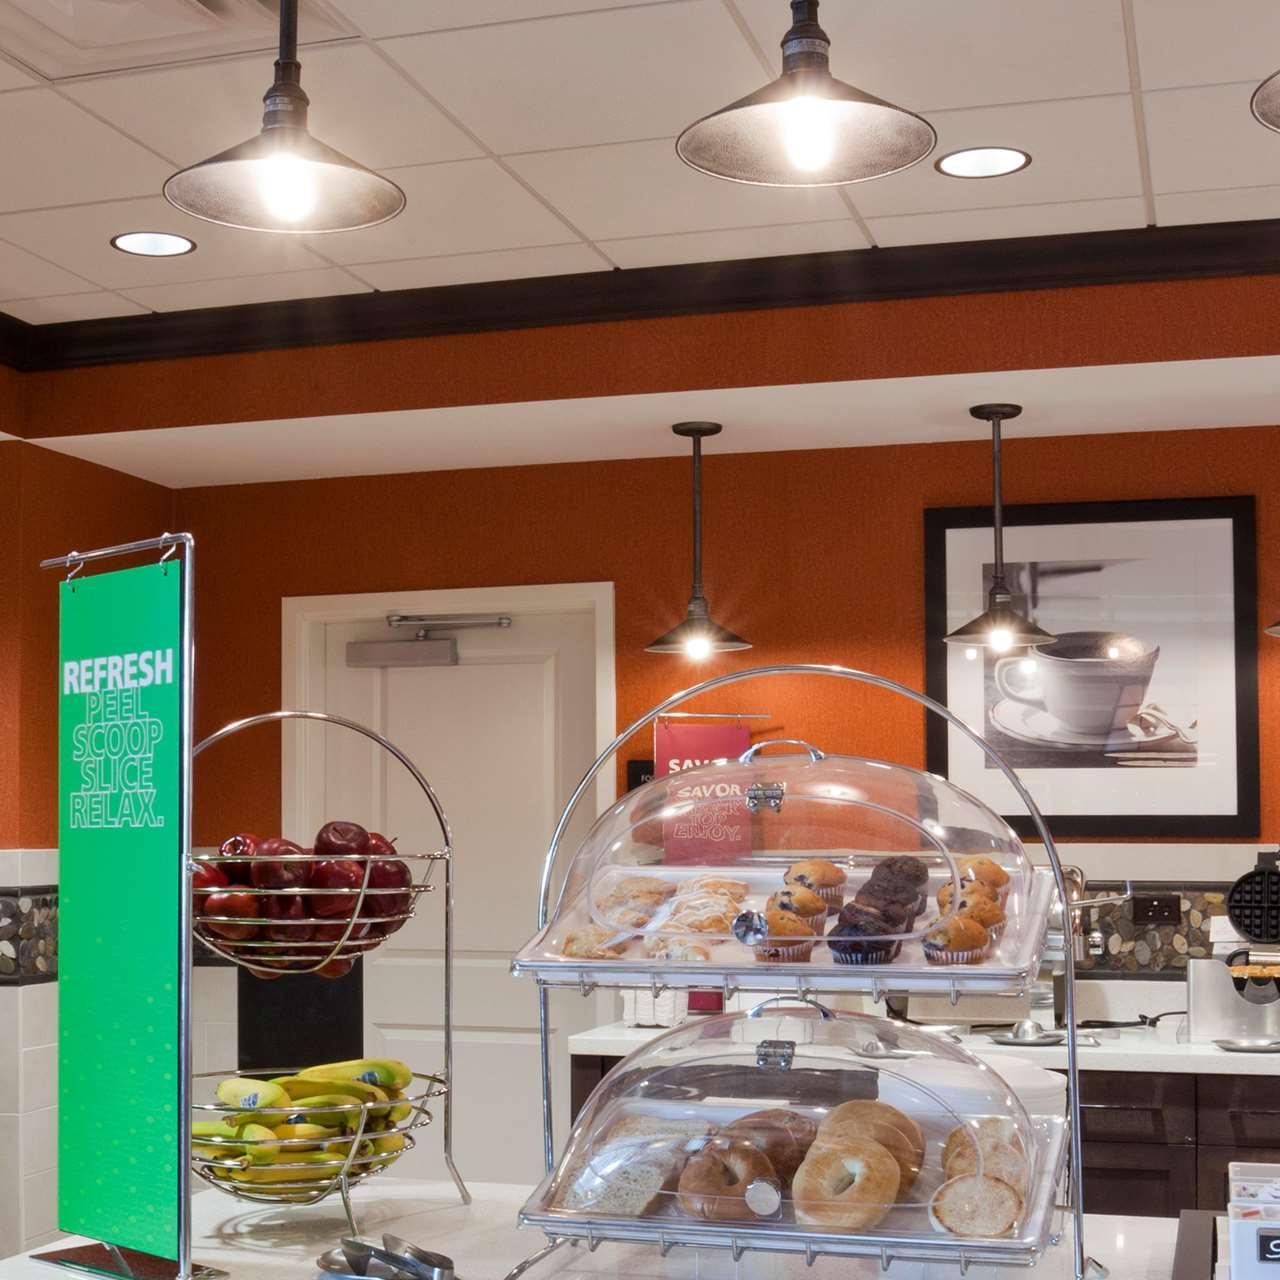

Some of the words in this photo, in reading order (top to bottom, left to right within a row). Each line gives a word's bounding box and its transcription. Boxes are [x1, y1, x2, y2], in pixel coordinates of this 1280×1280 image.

[63, 648, 173, 695] REFRESH
[86, 685, 149, 726] PEEL
[72, 718, 164, 762] SCOOP
[80, 754, 154, 794] SLICE
[677, 783, 742, 799] SAVOR
[70, 788, 165, 829] RELAX.
[672, 823, 743, 842] ENJOY.
